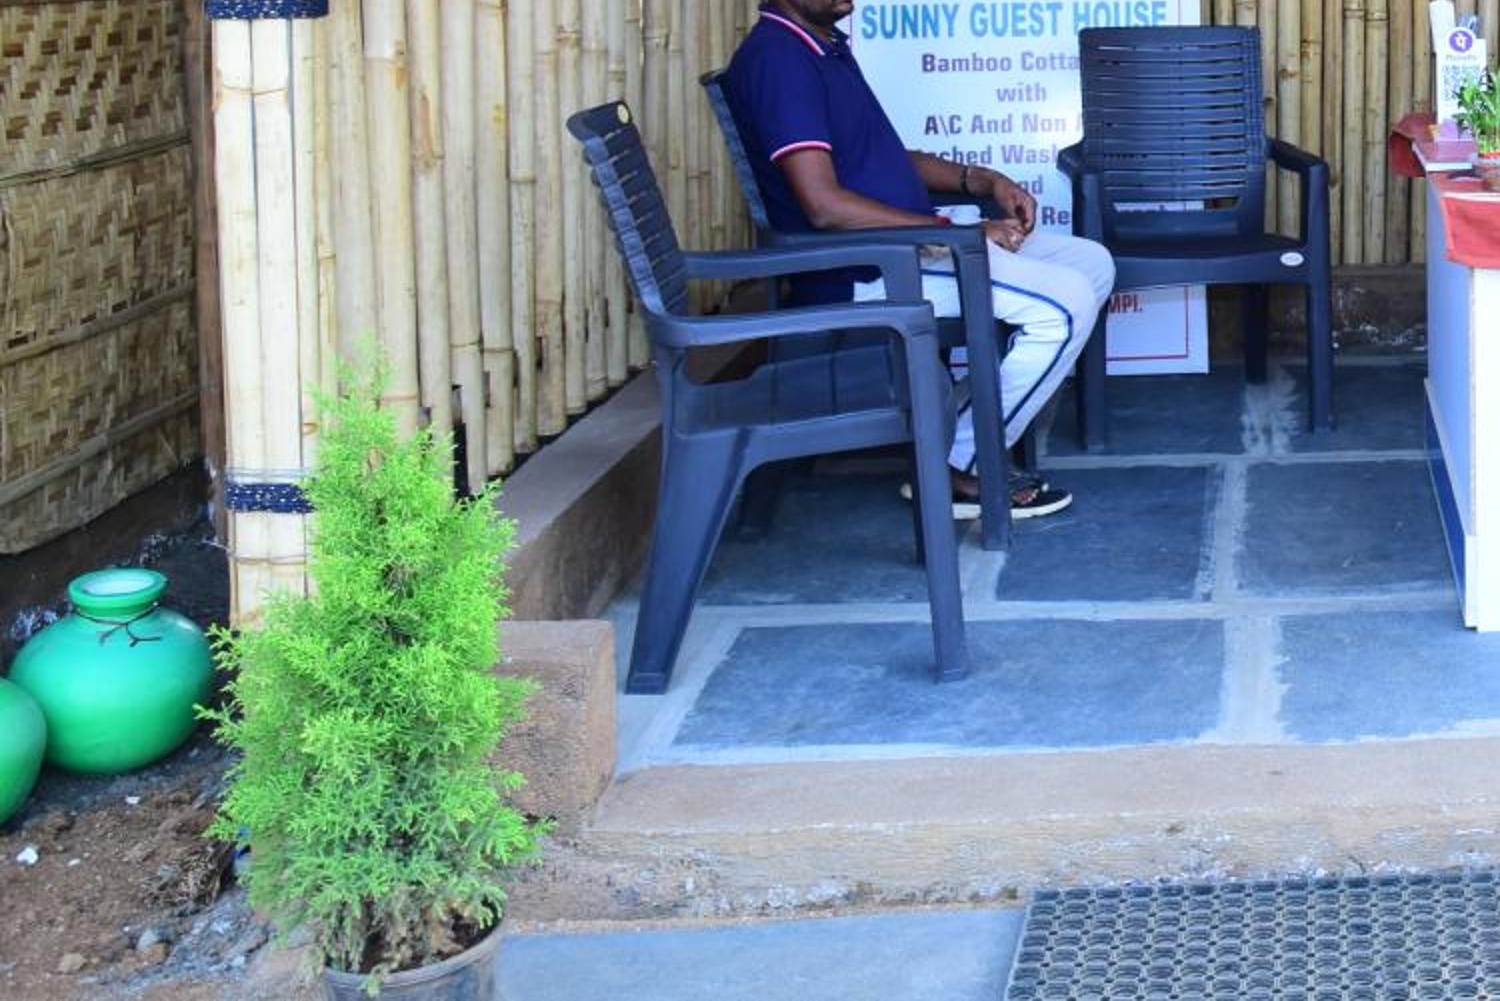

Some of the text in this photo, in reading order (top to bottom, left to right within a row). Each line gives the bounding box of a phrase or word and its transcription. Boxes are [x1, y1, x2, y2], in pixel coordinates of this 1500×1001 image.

[861, 0, 1167, 40] SUNNY GUEST HOUSE
[922, 51, 1081, 72] Bamboo Cotta
[996, 82, 1047, 103] with
[924, 114, 962, 136] A\C
[971, 114, 1013, 134] And
[1022, 114, 1067, 134] Non
[929, 144, 992, 165] ched
[1018, 175, 1043, 194] nd
[1042, 206, 1071, 226] Re
[1108, 294, 1143, 313] MPI.
